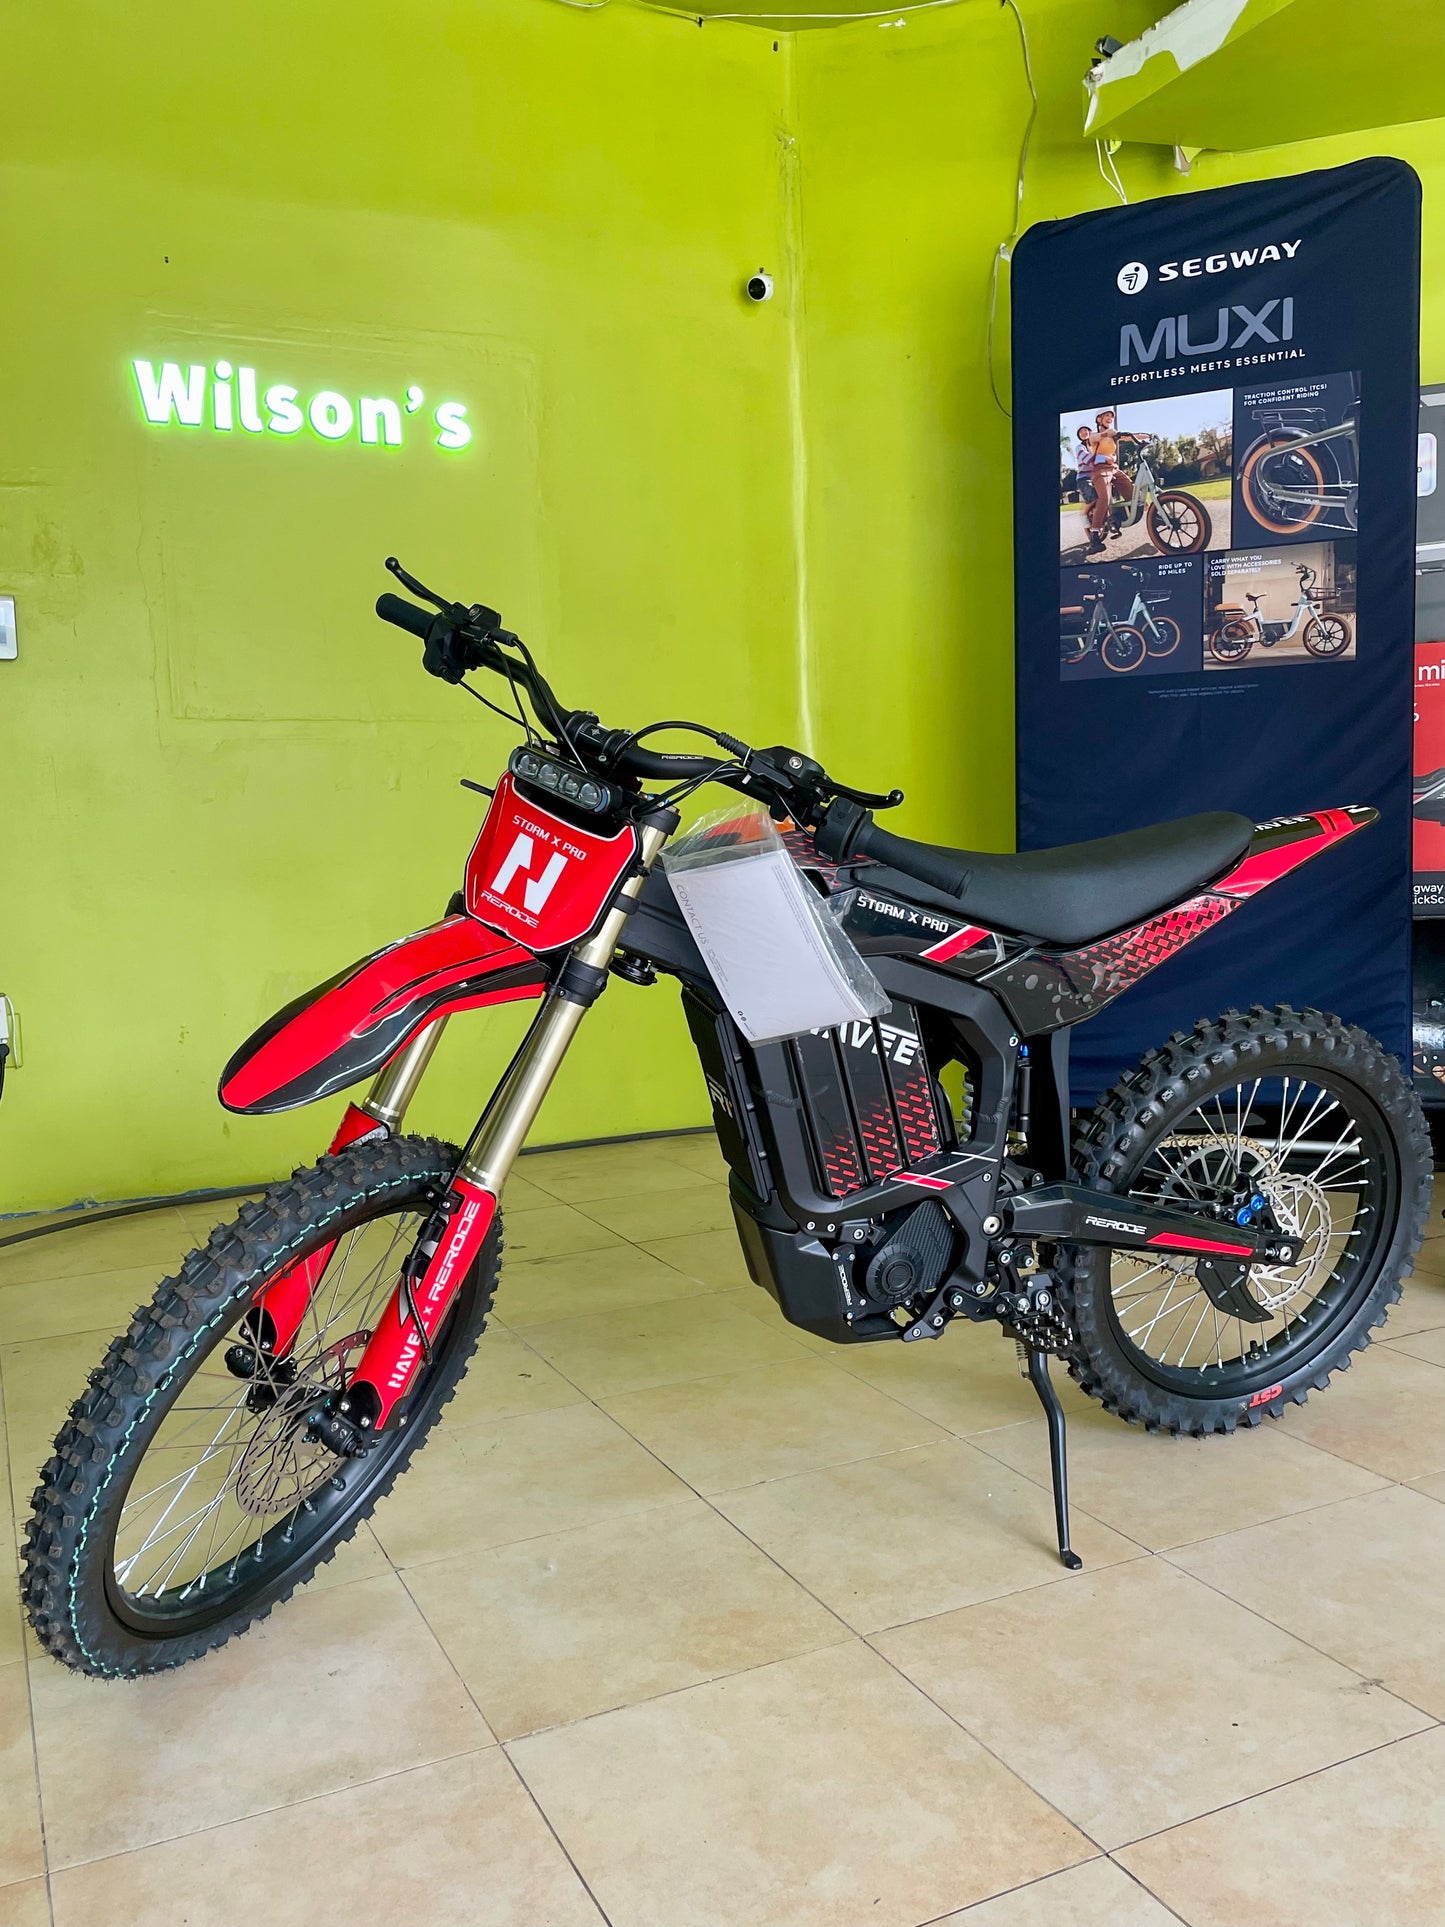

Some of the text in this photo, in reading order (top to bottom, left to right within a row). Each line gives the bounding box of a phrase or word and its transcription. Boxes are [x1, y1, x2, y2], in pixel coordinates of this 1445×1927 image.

[1158, 239, 1302, 282] SEGWAY
[1119, 296, 1294, 367] MUXI
[1110, 348, 1306, 386] EFFORTLESS MEETS ESSENTIAL
[132, 359, 472, 450] Wilson's
[1243, 391, 1276, 401] TRACTION
[1277, 386, 1308, 396] CONTROL
[1258, 394, 1295, 405] CONFIDENT
[1296, 390, 1319, 399] RIDING
[1210, 557, 1230, 565] CARRY
[1226, 567, 1261, 575] SEPARATELY
[1242, 558, 1282, 568] ACCESSORIES
[1254, 816, 1311, 832] AVEE
[512, 814, 587, 861] STORM X PRO
[1412, 894, 1445, 905] ickSc
[1413, 884, 1444, 895] gway
[480, 889, 540, 929] RERODE
[676, 883, 710, 946] CONTACT US
[856, 895, 949, 934] STORM X PRO
[1085, 1215, 1148, 1235] RERODE
[428, 1200, 481, 1302] RERODE
[1249, 1384, 1284, 1408] CST
